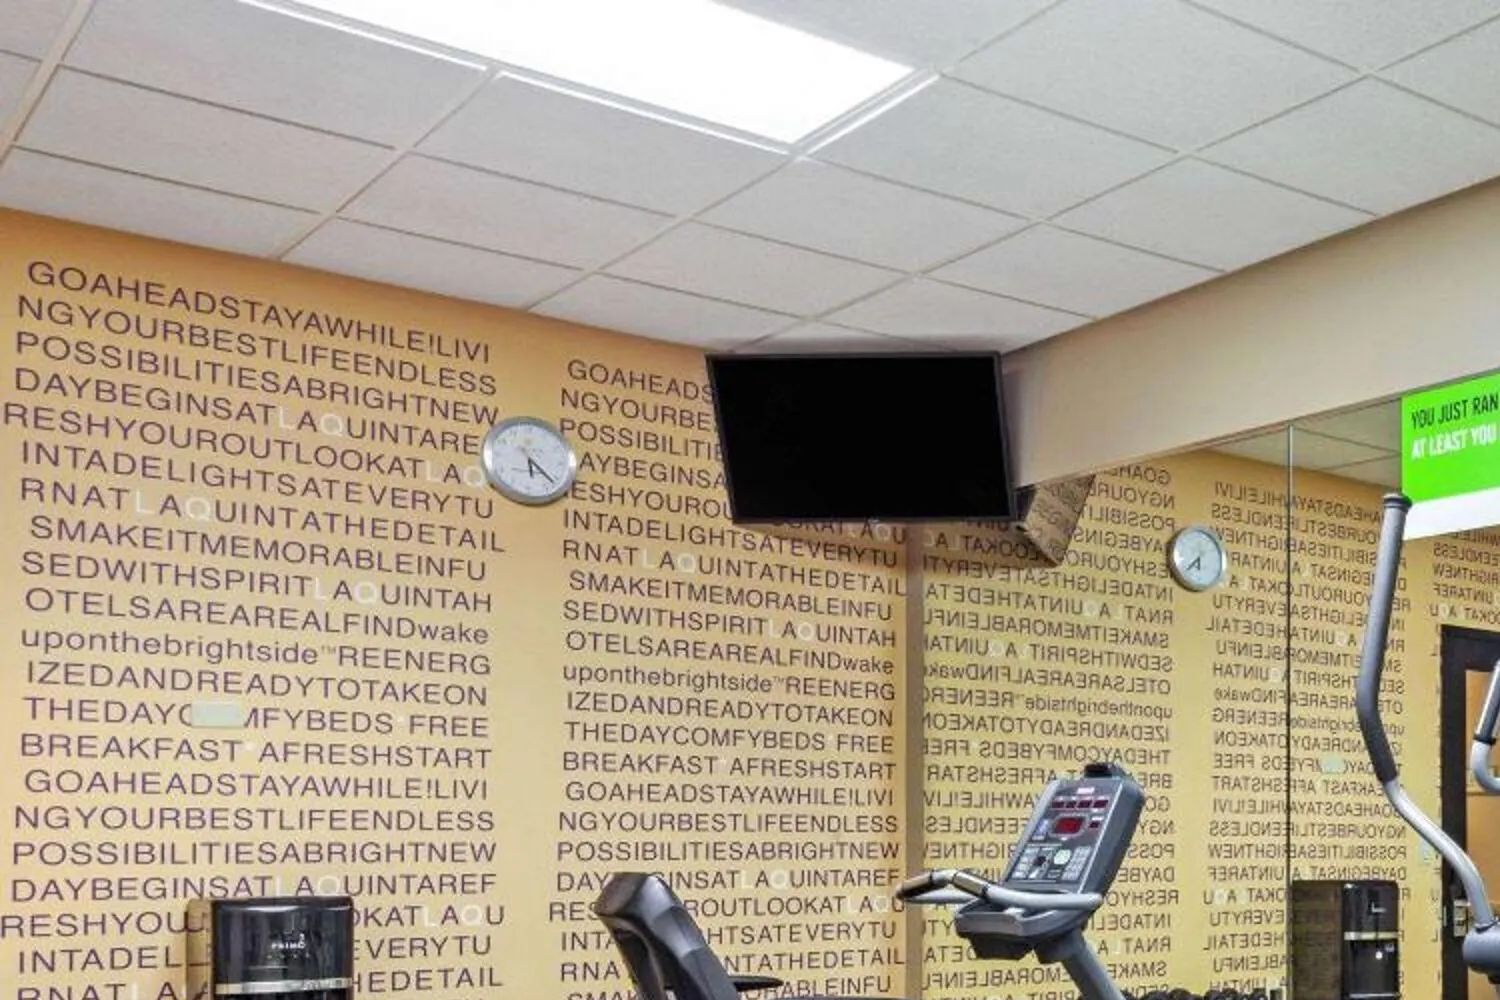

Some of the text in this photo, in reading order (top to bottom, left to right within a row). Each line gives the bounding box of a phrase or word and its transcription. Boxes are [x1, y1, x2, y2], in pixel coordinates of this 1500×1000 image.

[18, 295, 497, 395] NGYOURBESTLIFEENDLESS
[16, 331, 499, 425] POSSIBILITIESABRIGHTNEW
[15, 368, 482, 456] DAYBEGINSATLAQUINTARE
[1411, 407, 1435, 429] YOU
[1438, 399, 1468, 425] JUST
[1472, 392, 1499, 415] RAN
[3, 403, 486, 489] RESHYOUROUTLOOKATLAQ
[1411, 436, 1426, 460] AT
[1429, 427, 1470, 457] LEAST
[1471, 422, 1497, 446] YOU
[22, 441, 494, 519] INTADELIGHTSATEVERYTU
[31, 515, 486, 581] SMAKEITMEMORABLEINFU
[563, 509, 897, 569] INTADELIGHTSATEVERYTU
[25, 587, 488, 645] OTELSAREAREALFINDwake
[569, 570, 892, 621] SMAKEITMEMORABLEINFU
[566, 631, 895, 675] OTELSAREAREALFINDwake
[27, 661, 487, 706] IZEDANDREADYTOTAKEON
[409, 714, 488, 738] FREE
[567, 692, 893, 728] IZEDANDREADYTOTAKEON
[21, 733, 492, 769] BREAKFAST AFRESHSTART
[564, 721, 894, 754] THEDAYCOMFYBEDS FREE
[563, 752, 896, 781] BREAKFAST AFRESHSTART
[15, 806, 495, 832] NGYOURBESTLIFEENDLESS
[559, 811, 898, 833] NGYOURBESTLIFEENDLESS
[13, 842, 497, 865] POSSIBILITIESABRIGHTNEW
[557, 841, 899, 862] POSSIBILITIESABRIGHTNEW
